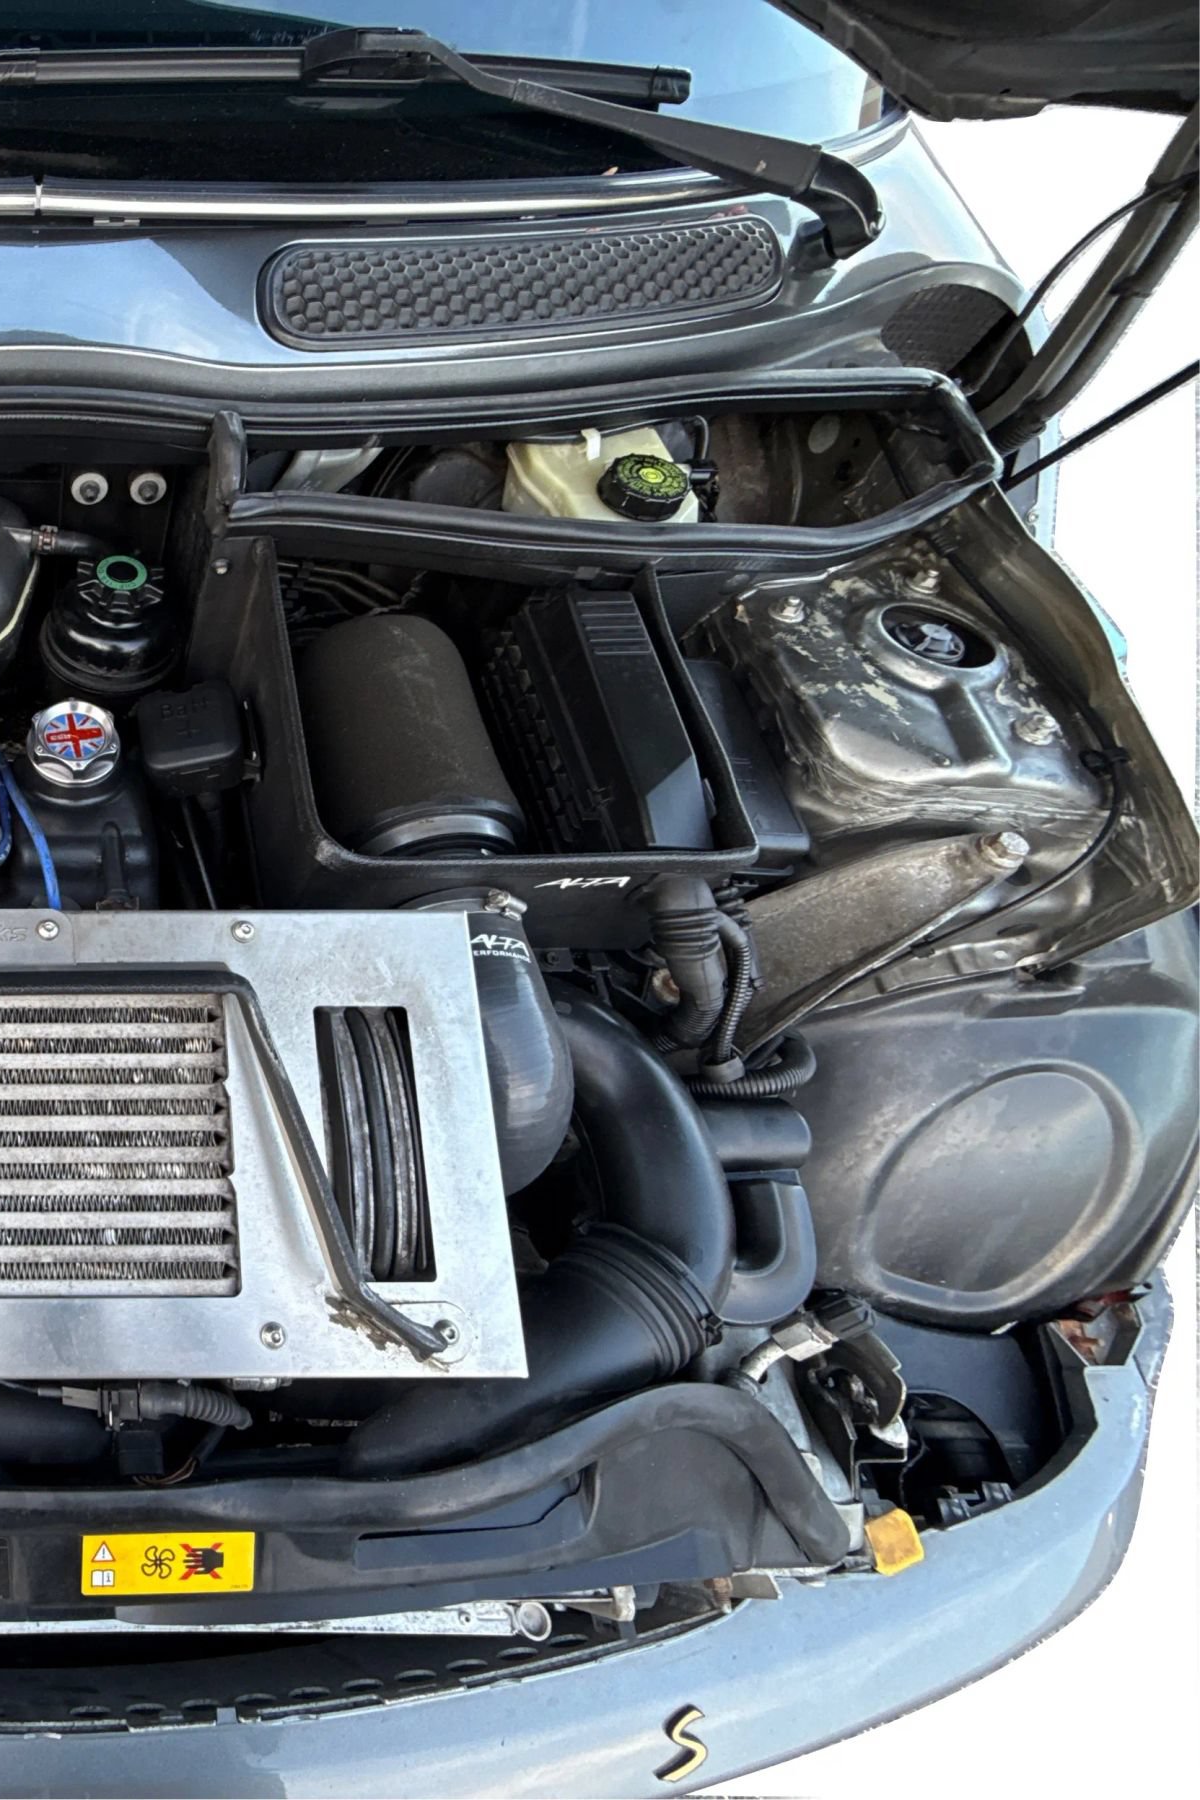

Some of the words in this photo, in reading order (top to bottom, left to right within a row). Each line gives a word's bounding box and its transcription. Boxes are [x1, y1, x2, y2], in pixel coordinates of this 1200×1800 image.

[534, 876, 631, 889] ALTA
[471, 933, 530, 957] ALTA
[652, 1704, 708, 1782] S
